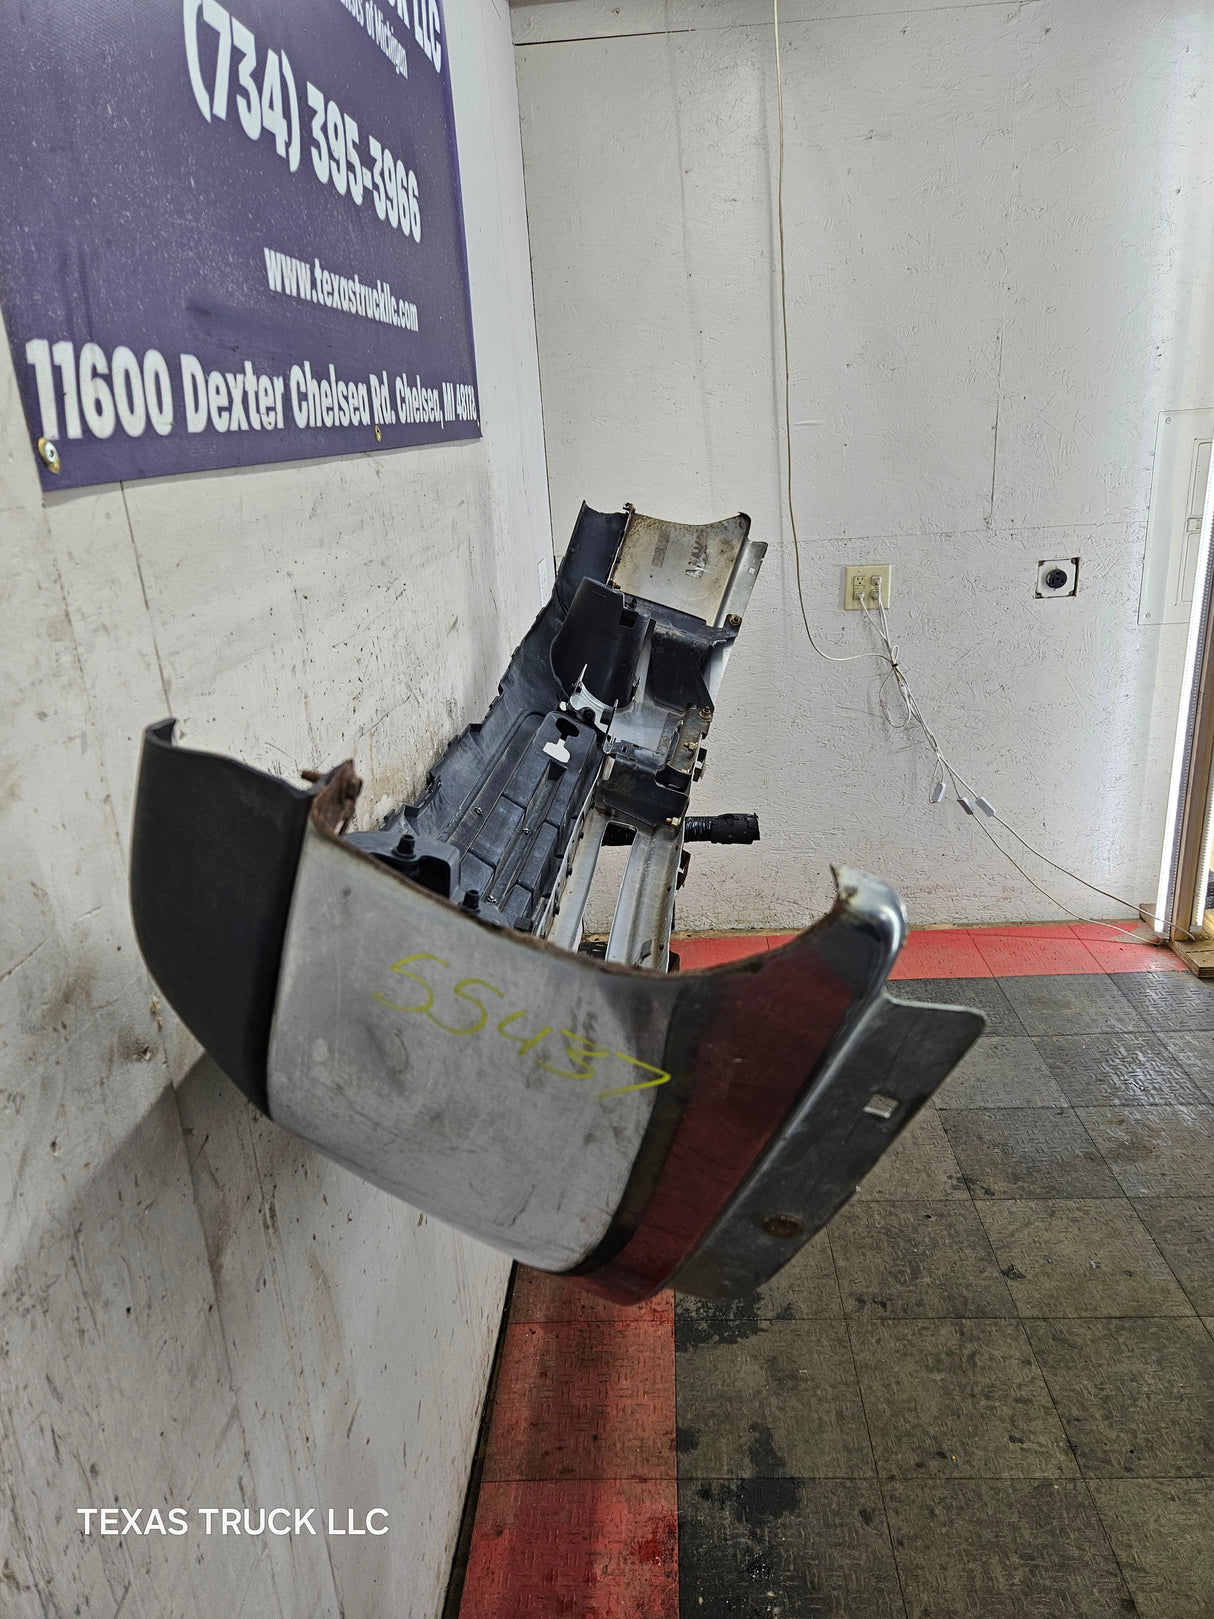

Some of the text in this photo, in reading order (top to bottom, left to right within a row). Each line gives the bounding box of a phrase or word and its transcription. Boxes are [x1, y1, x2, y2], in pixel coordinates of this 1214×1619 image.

[365, 0, 375, 40] of
[374, 3, 408, 79] Michigan
[413, 0, 442, 74] LLC
[183, 0, 421, 243] (734) 395-3966
[264, 247, 418, 332] www.texastruckllc.com
[25, 339, 478, 440] 11600 Dexter Chelsea Rd. Chelsea, MI 48118
